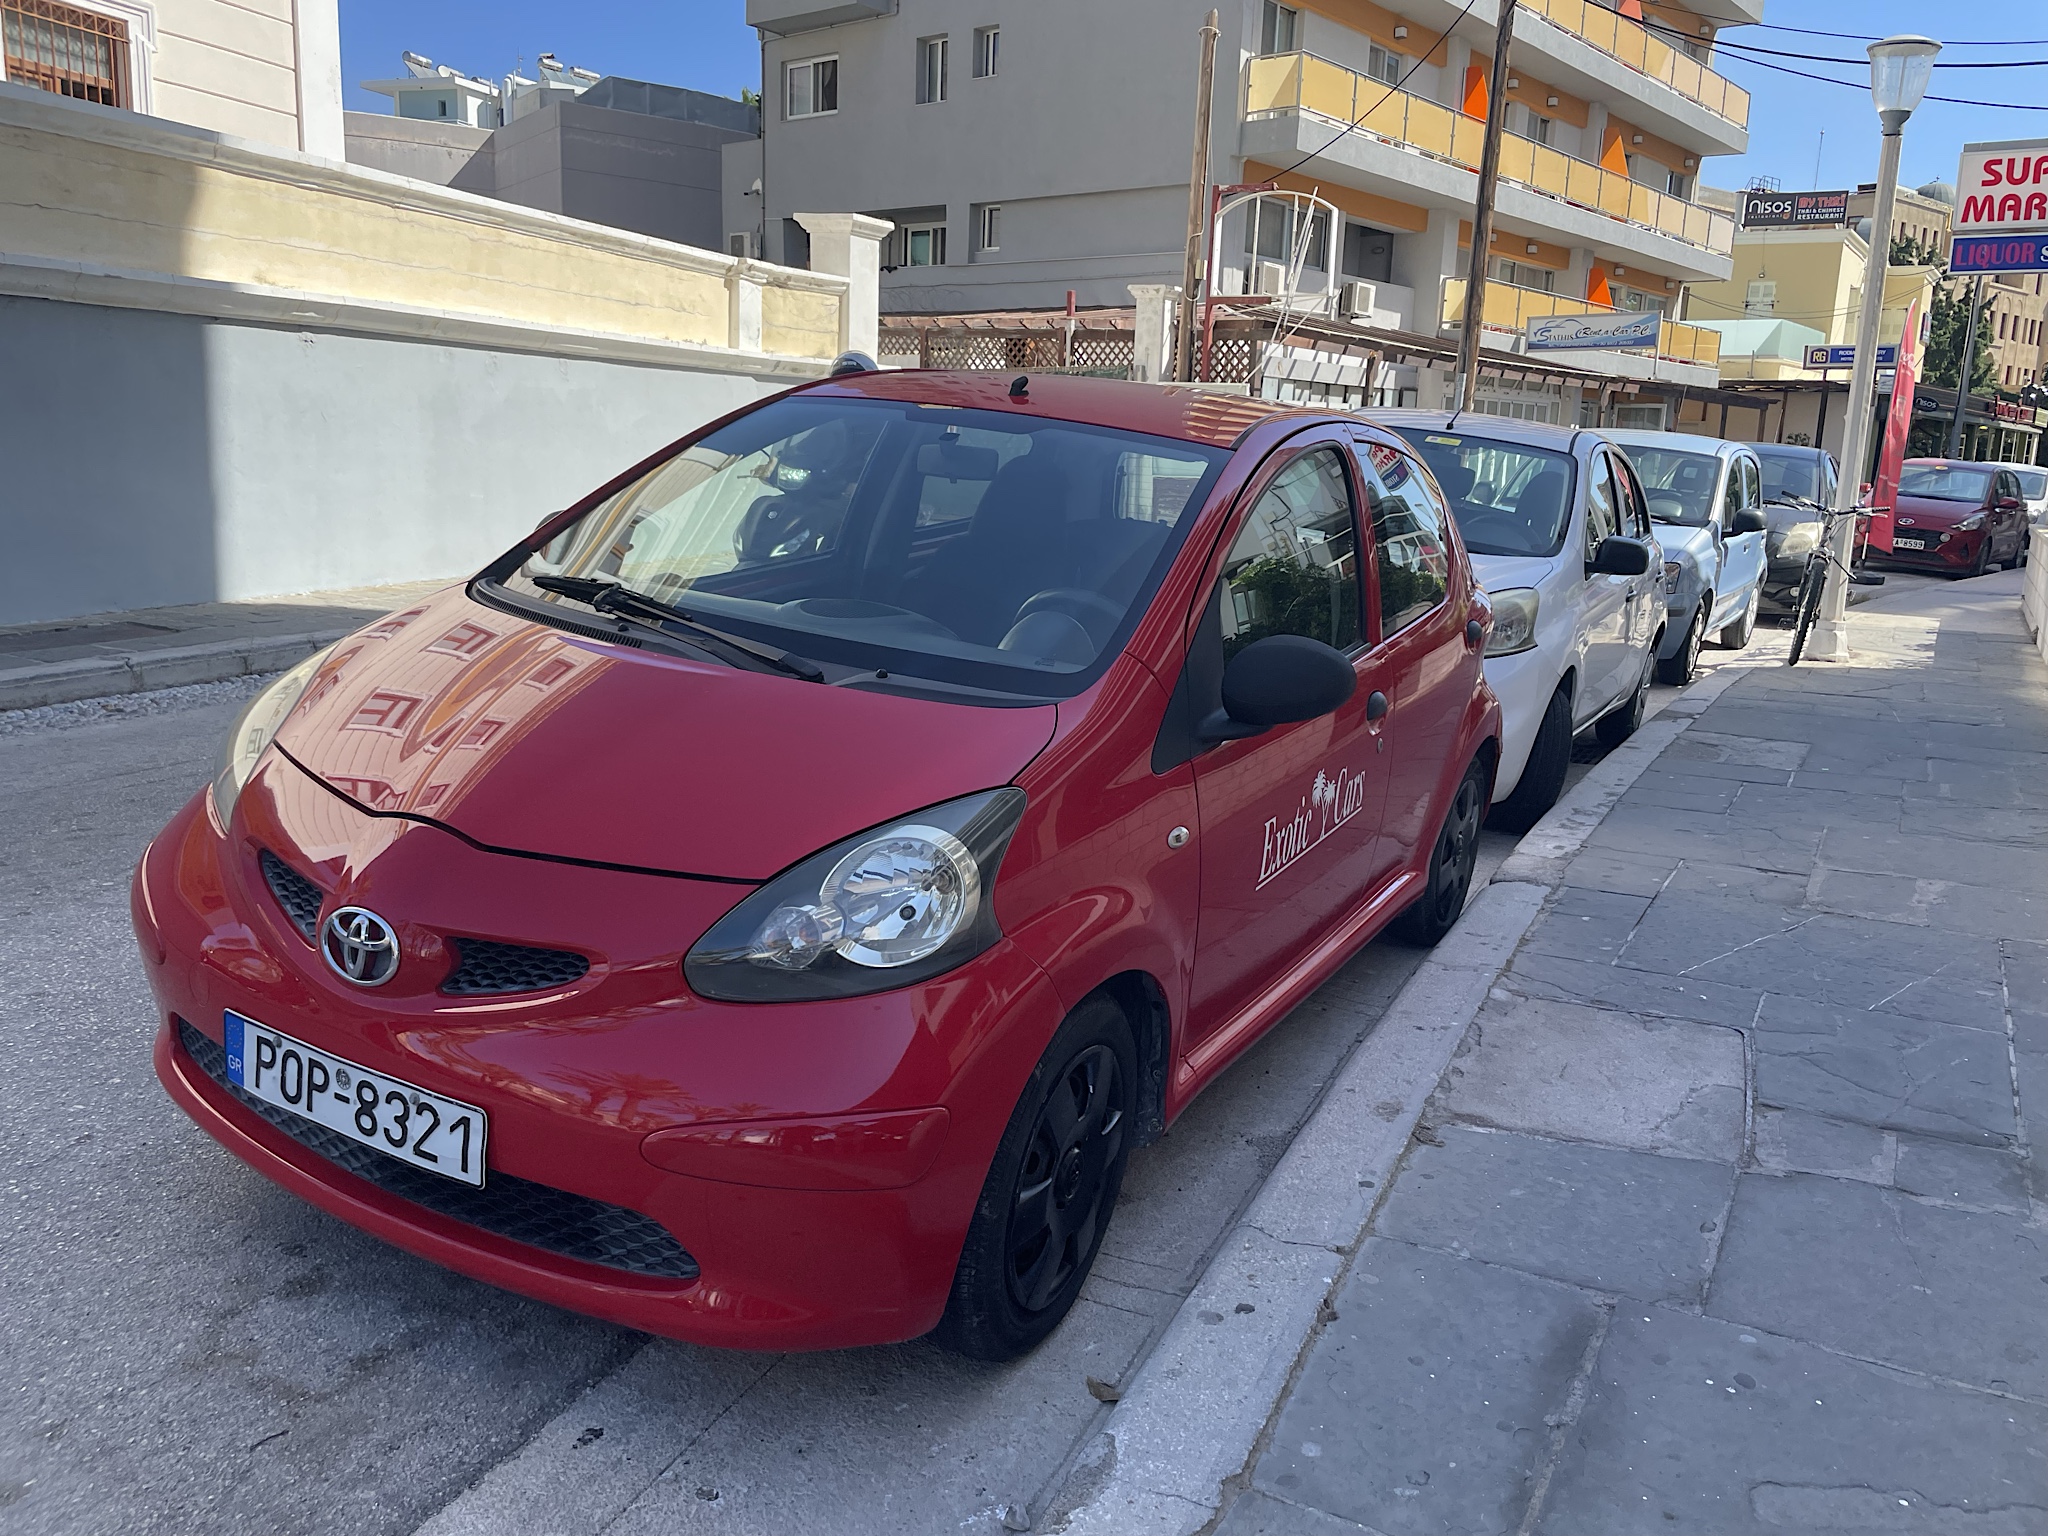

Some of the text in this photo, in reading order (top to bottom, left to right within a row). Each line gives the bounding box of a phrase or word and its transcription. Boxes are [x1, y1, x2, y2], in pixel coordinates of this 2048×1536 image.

[1955, 242, 2036, 268] LIQUOR
[1813, 351, 1826, 362] RG
[1258, 766, 1366, 883] Exotic Cars
[228, 1054, 242, 1075] GR
[255, 1034, 471, 1174] POP-8321
